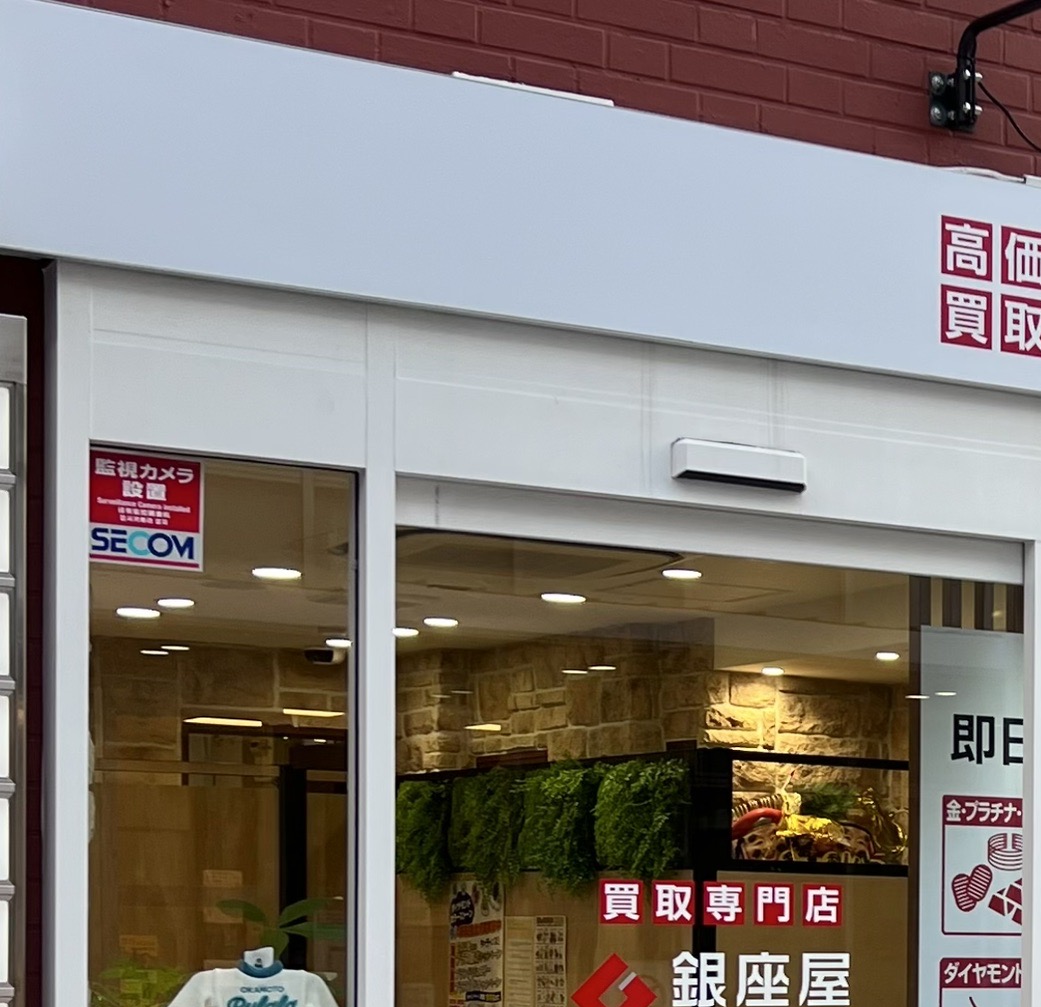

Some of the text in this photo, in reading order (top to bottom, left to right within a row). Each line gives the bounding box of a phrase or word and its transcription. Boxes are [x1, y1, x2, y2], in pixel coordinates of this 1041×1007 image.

[95, 457, 194, 484] 監視カメラ
[91, 527, 194, 560] SECOM
[603, 882, 840, 924] 買取専門店
[671, 951, 850, 1007] 銀座屋
